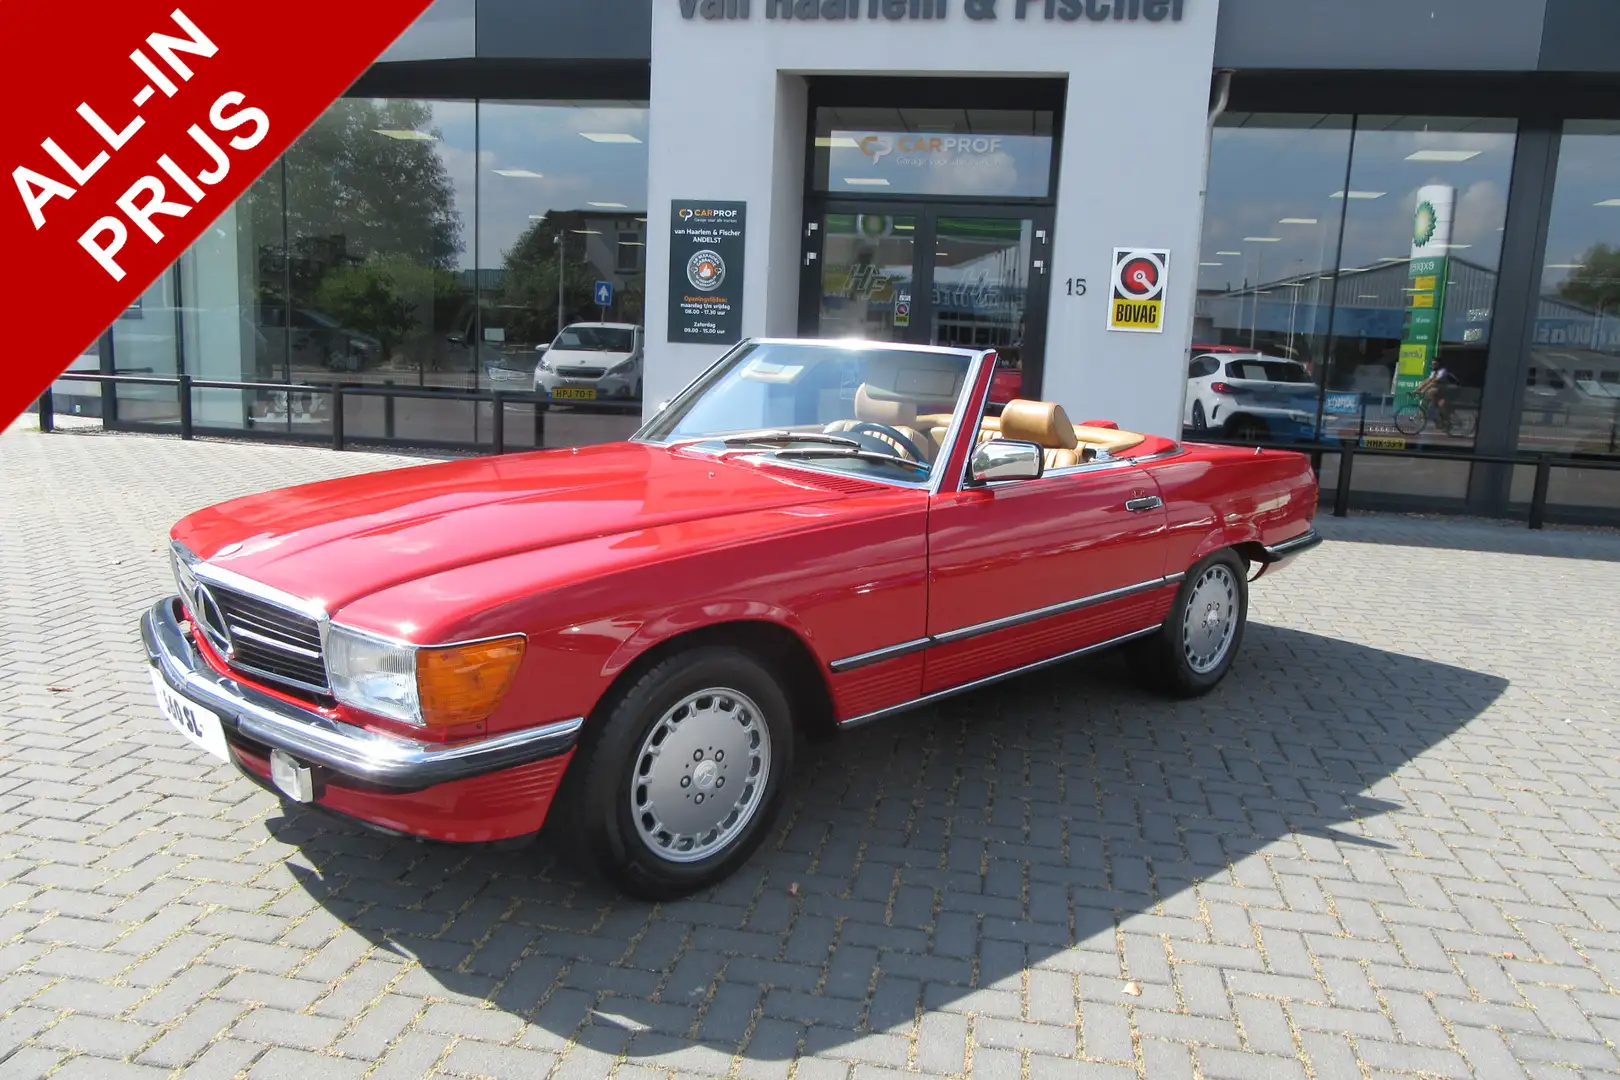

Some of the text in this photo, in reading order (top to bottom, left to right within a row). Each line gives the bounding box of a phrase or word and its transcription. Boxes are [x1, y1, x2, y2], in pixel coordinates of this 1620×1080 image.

[897, 135, 1003, 153] CARPROF
[694, 209, 738, 217] CARPROF
[1065, 277, 1087, 296] 15
[1115, 303, 1157, 324] BOVAG
